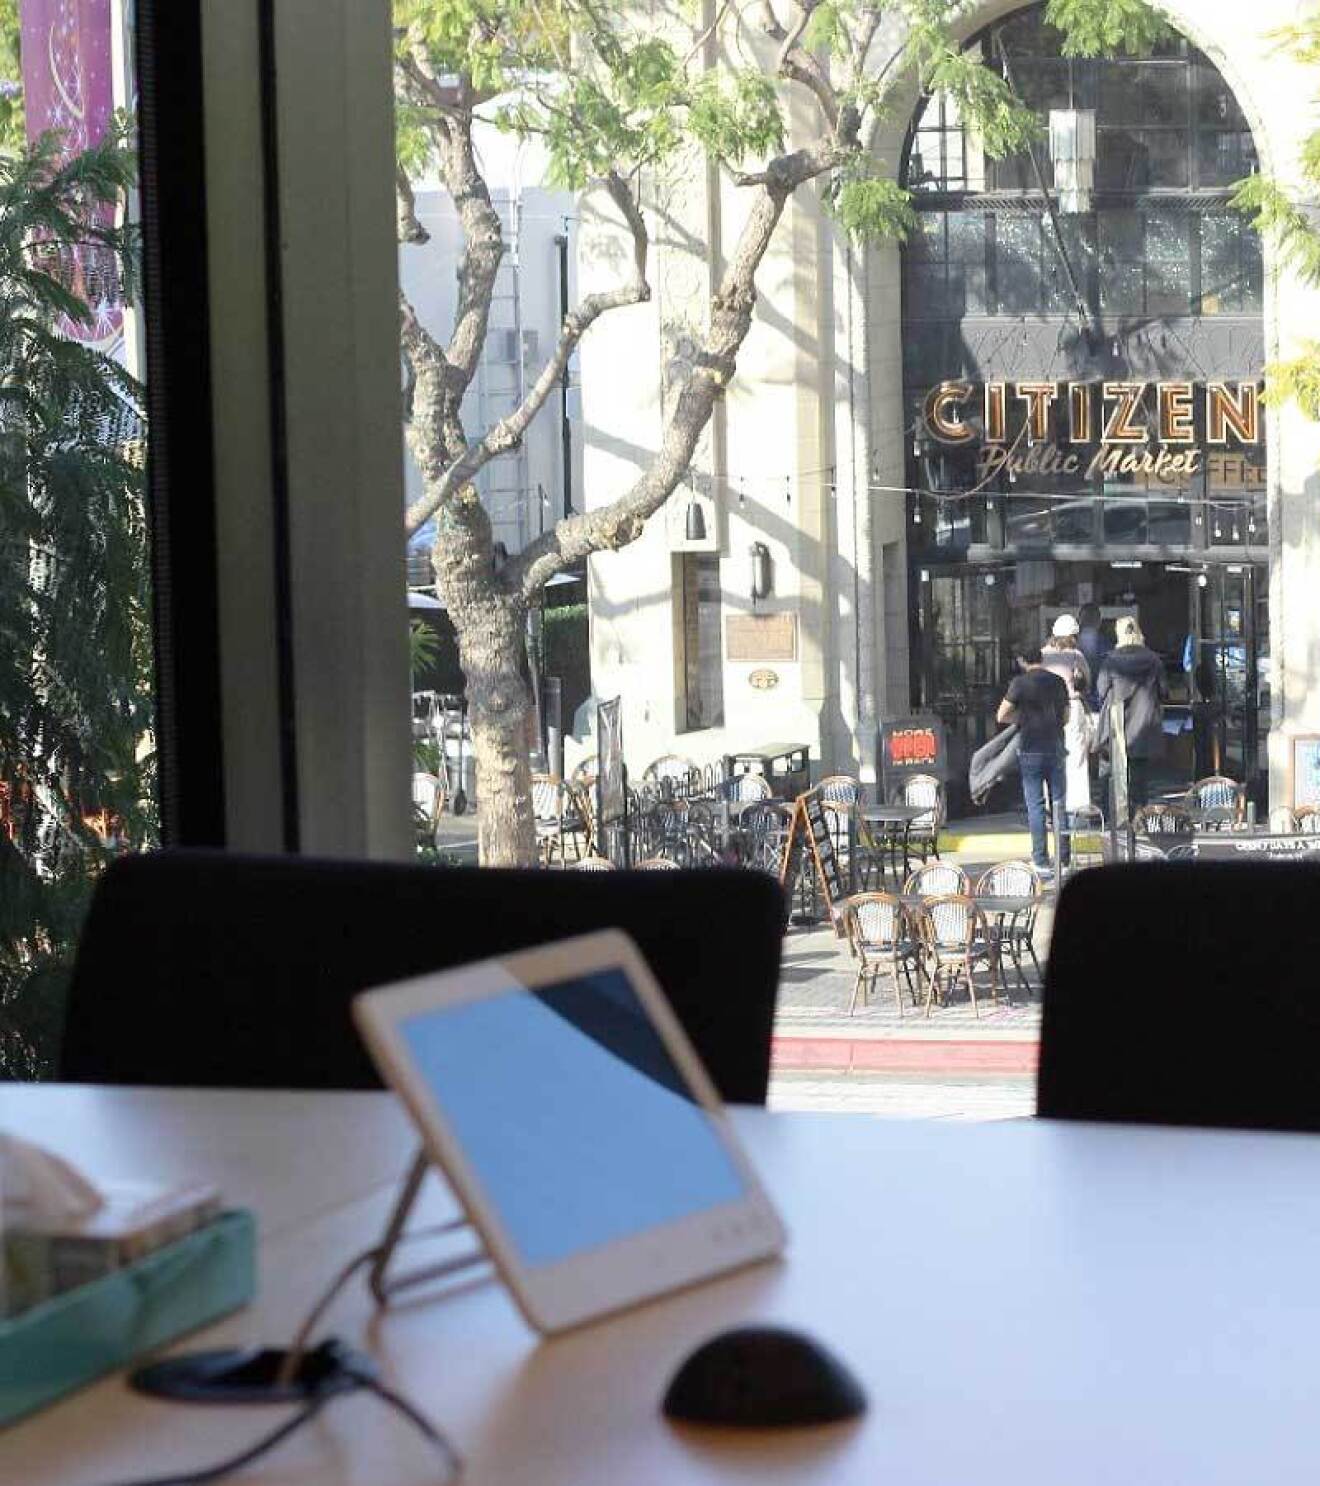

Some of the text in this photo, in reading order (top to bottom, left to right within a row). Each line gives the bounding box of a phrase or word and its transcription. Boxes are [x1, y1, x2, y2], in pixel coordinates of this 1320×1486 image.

[922, 380, 1258, 444] CITIZEN
[976, 443, 1201, 481] Public Market
